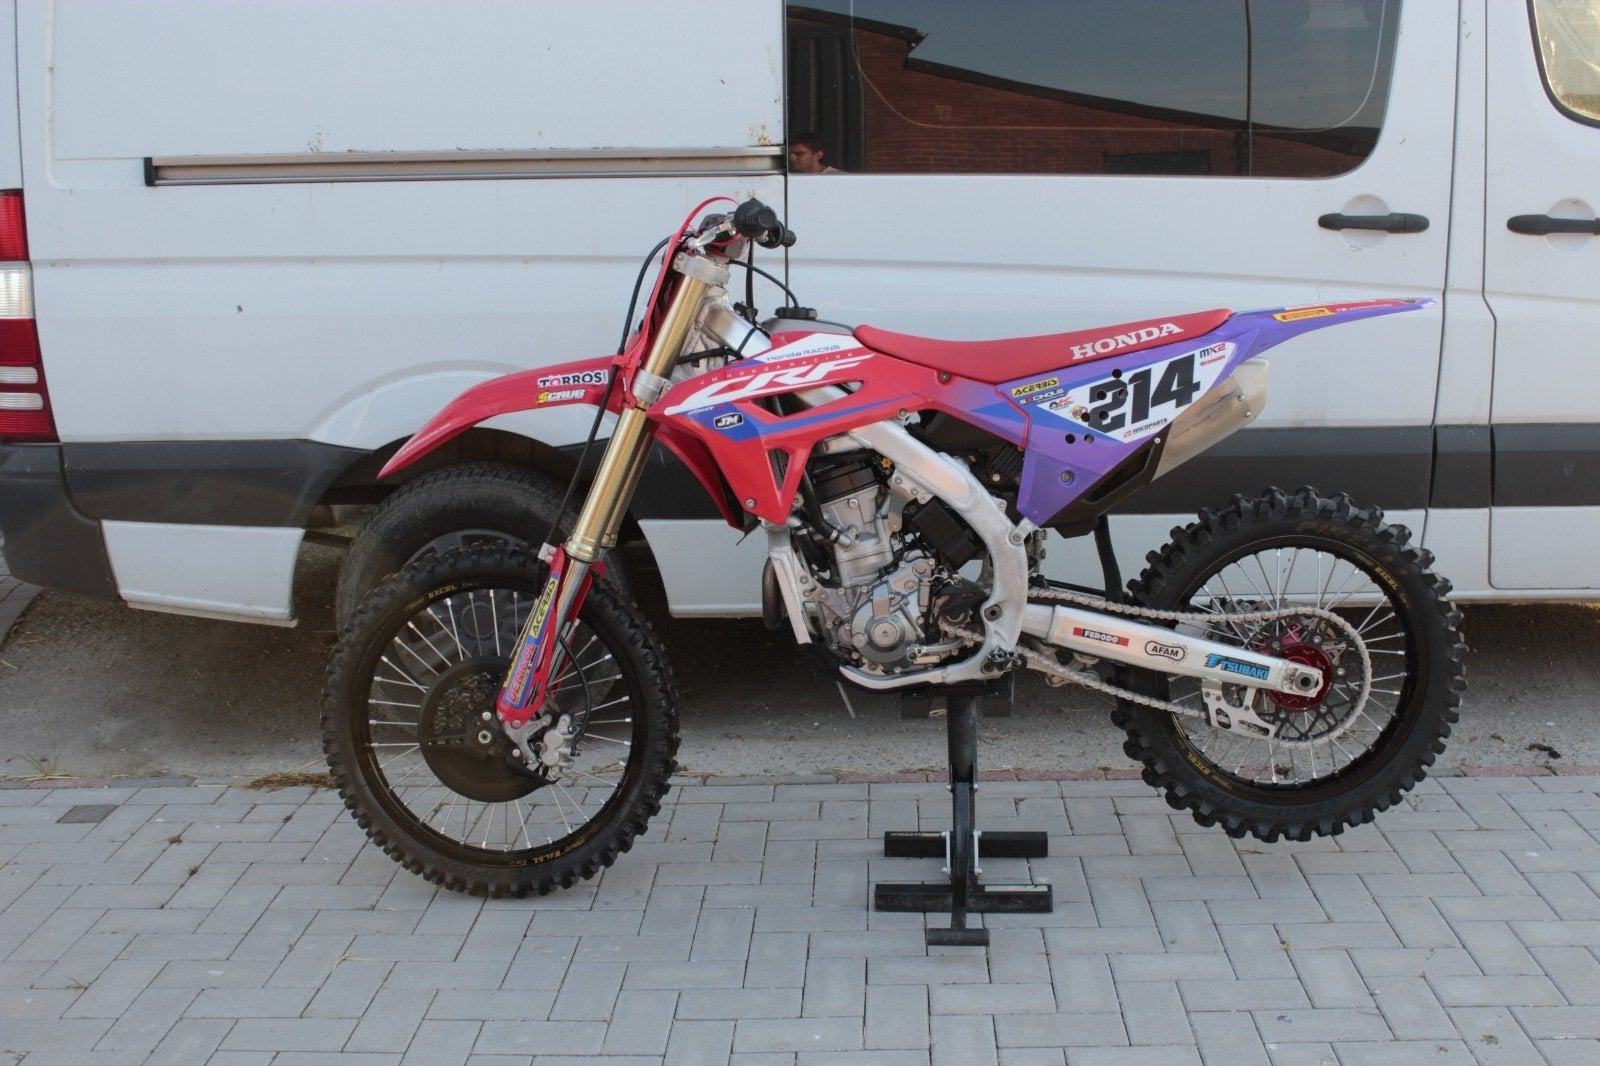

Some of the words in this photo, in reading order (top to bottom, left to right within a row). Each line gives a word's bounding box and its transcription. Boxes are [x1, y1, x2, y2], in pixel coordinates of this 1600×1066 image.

[803, 344, 841, 355] RACING
[1069, 322, 1184, 360] HONDA
[663, 353, 877, 416] CRF
[1088, 353, 1201, 434] 214
[1374, 566, 1399, 591] EXCEL
[428, 584, 458, 599] EXCEL
[1083, 630, 1120, 645] FERODO
[1150, 646, 1180, 658] AFAM
[1219, 659, 1270, 681] TSUBAKI
[1187, 752, 1212, 776] EXCEL
